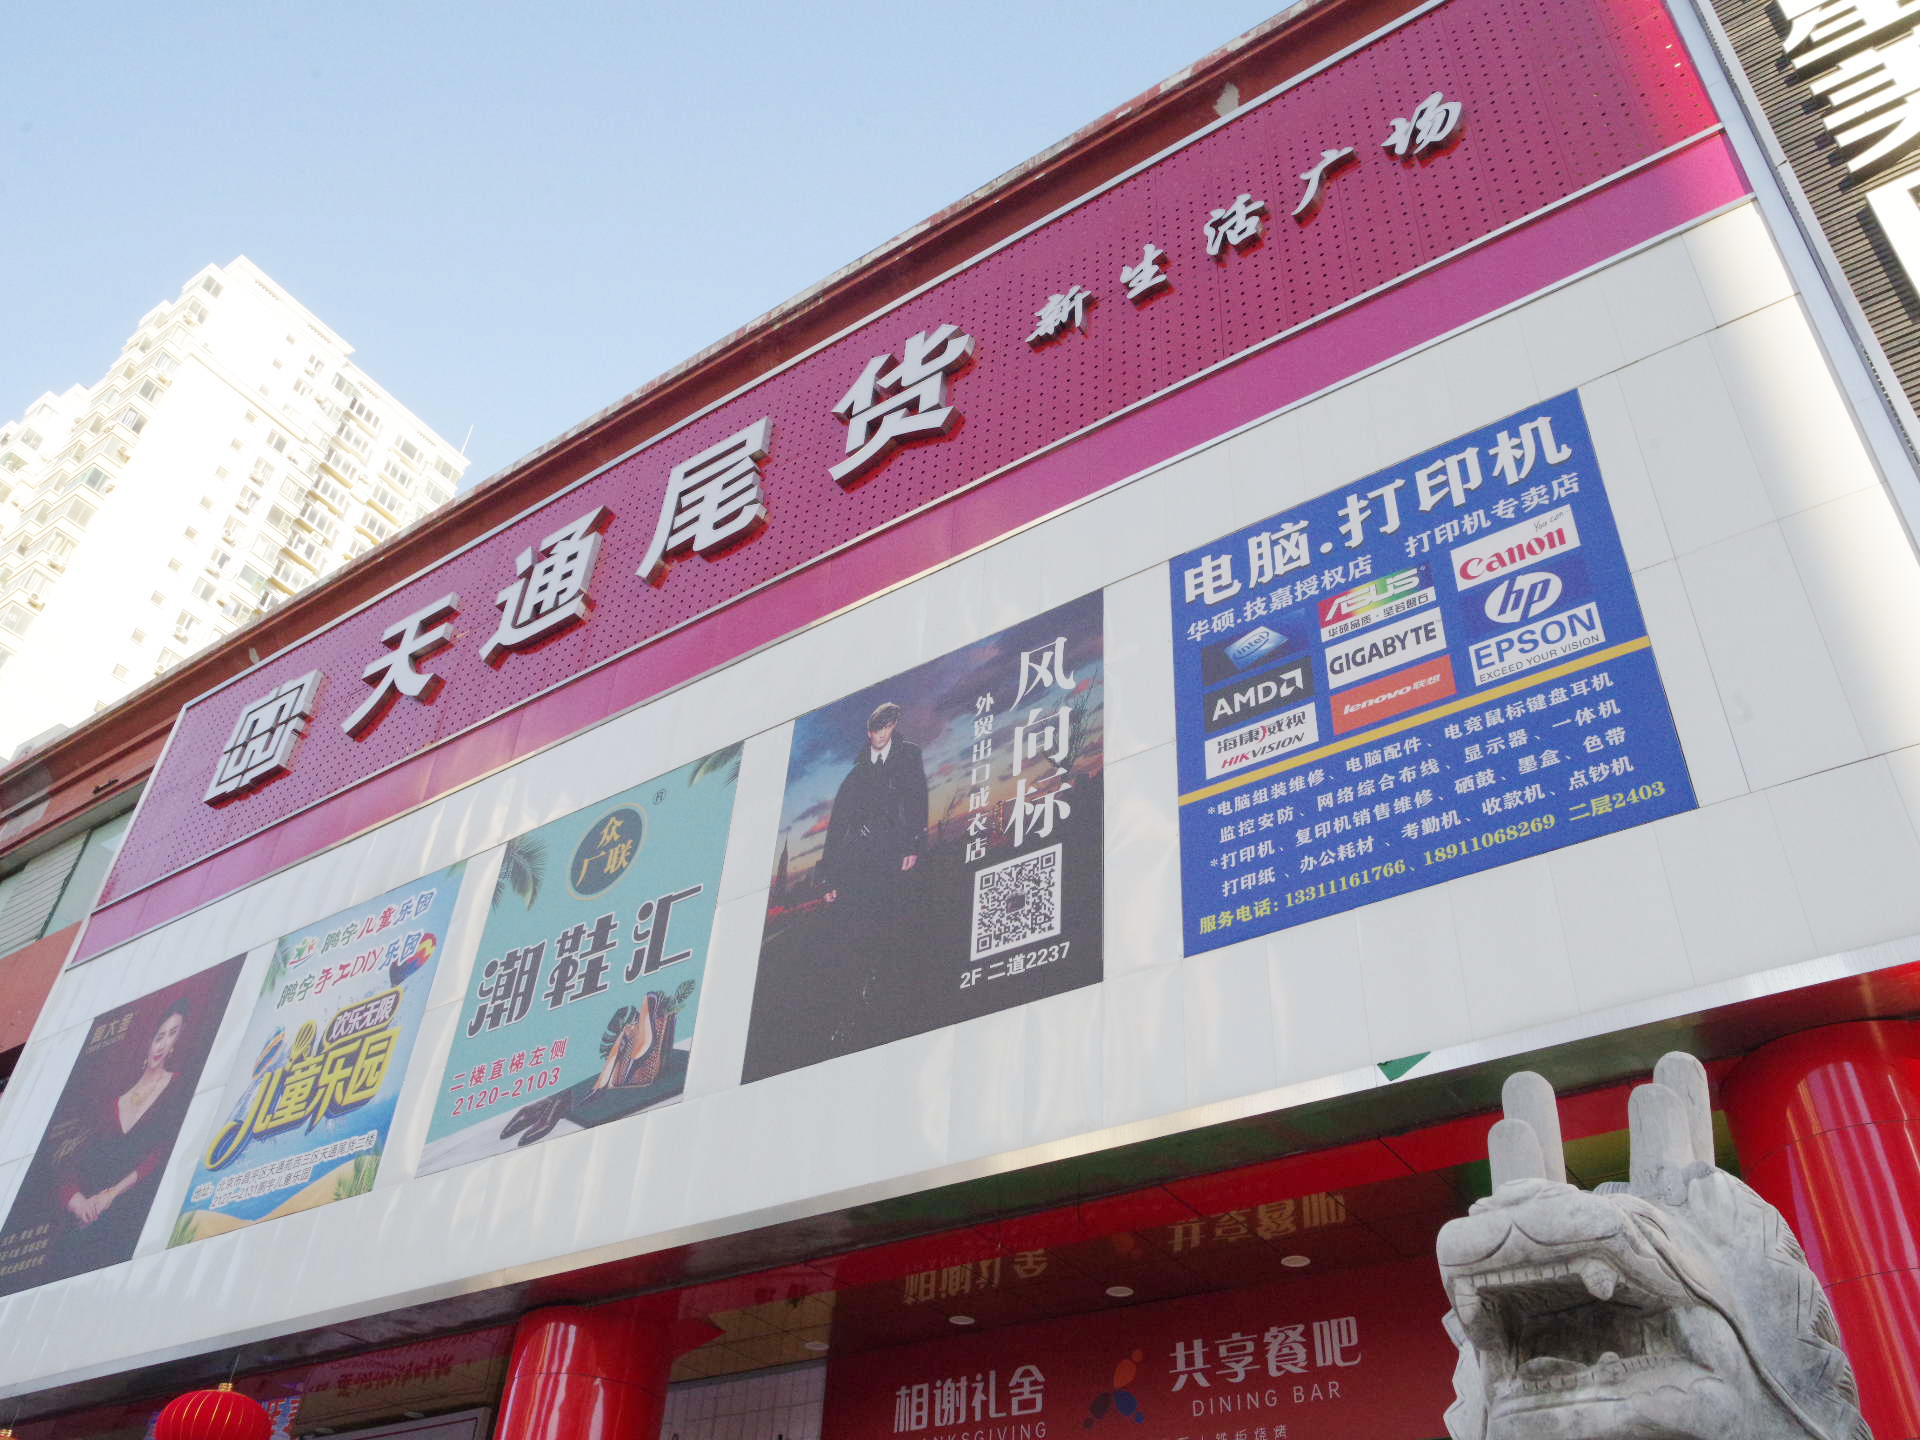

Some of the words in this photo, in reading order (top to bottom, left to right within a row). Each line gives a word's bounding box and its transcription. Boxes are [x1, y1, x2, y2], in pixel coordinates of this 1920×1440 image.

[1025, 91, 1463, 343] 新生活广场
[1405, 472, 1581, 558] 打印机专卖店
[1459, 527, 1567, 580] Canon
[1325, 568, 1420, 621] ASUS
[1496, 576, 1552, 622] hp
[1329, 620, 1437, 676] GIGABYTE
[1473, 608, 1597, 670] EPSON
[1479, 661, 1523, 682] EXCEED
[1526, 649, 1557, 665] YOUR
[1561, 634, 1600, 653] VISION
[1212, 681, 1278, 721] AMD
[1003, 636, 1076, 848] 风向标
[1217, 710, 1306, 754] 海康威视
[1221, 732, 1305, 768] HIKVISION
[965, 691, 995, 864] 外贸出口成衣店
[466, 883, 704, 1039] 潮鞋汇
[959, 967, 983, 989] 2F
[449, 1037, 569, 1094] 二楼直梯左侧
[450, 1066, 562, 1118] 2120-2103
[205, 1027, 401, 1171] 儿童乐园
[1169, 1316, 1362, 1392] 共享餐吧
[894, 1365, 1046, 1433] 相谢礼舍
[1192, 1390, 1278, 1417] DINING
[1292, 1380, 1342, 1404] BAR
